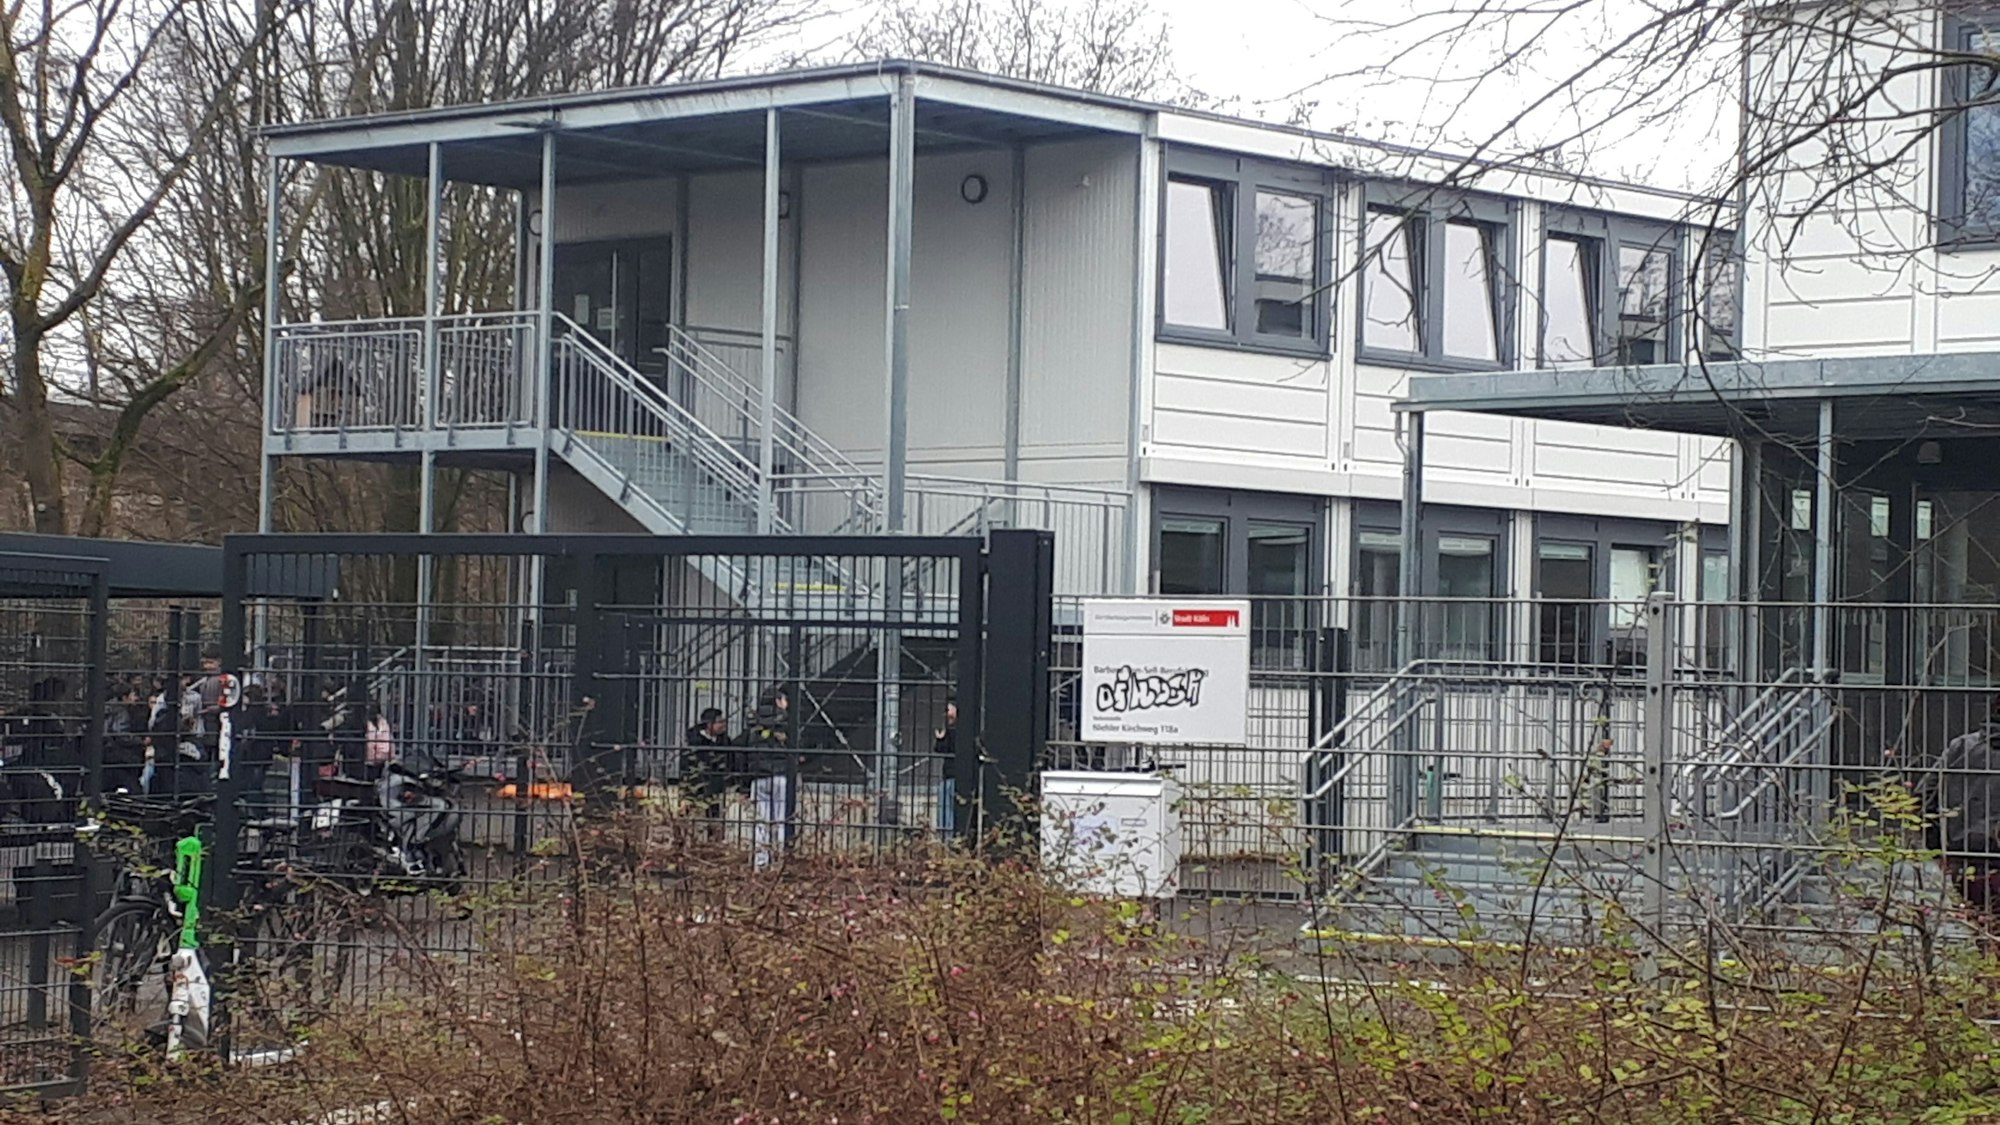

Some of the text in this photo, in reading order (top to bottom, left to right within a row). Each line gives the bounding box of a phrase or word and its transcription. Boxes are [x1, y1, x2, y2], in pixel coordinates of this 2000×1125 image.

[1174, 614, 1210, 623] Stadt Köln
[1121, 723, 1159, 735] Kirchweg
